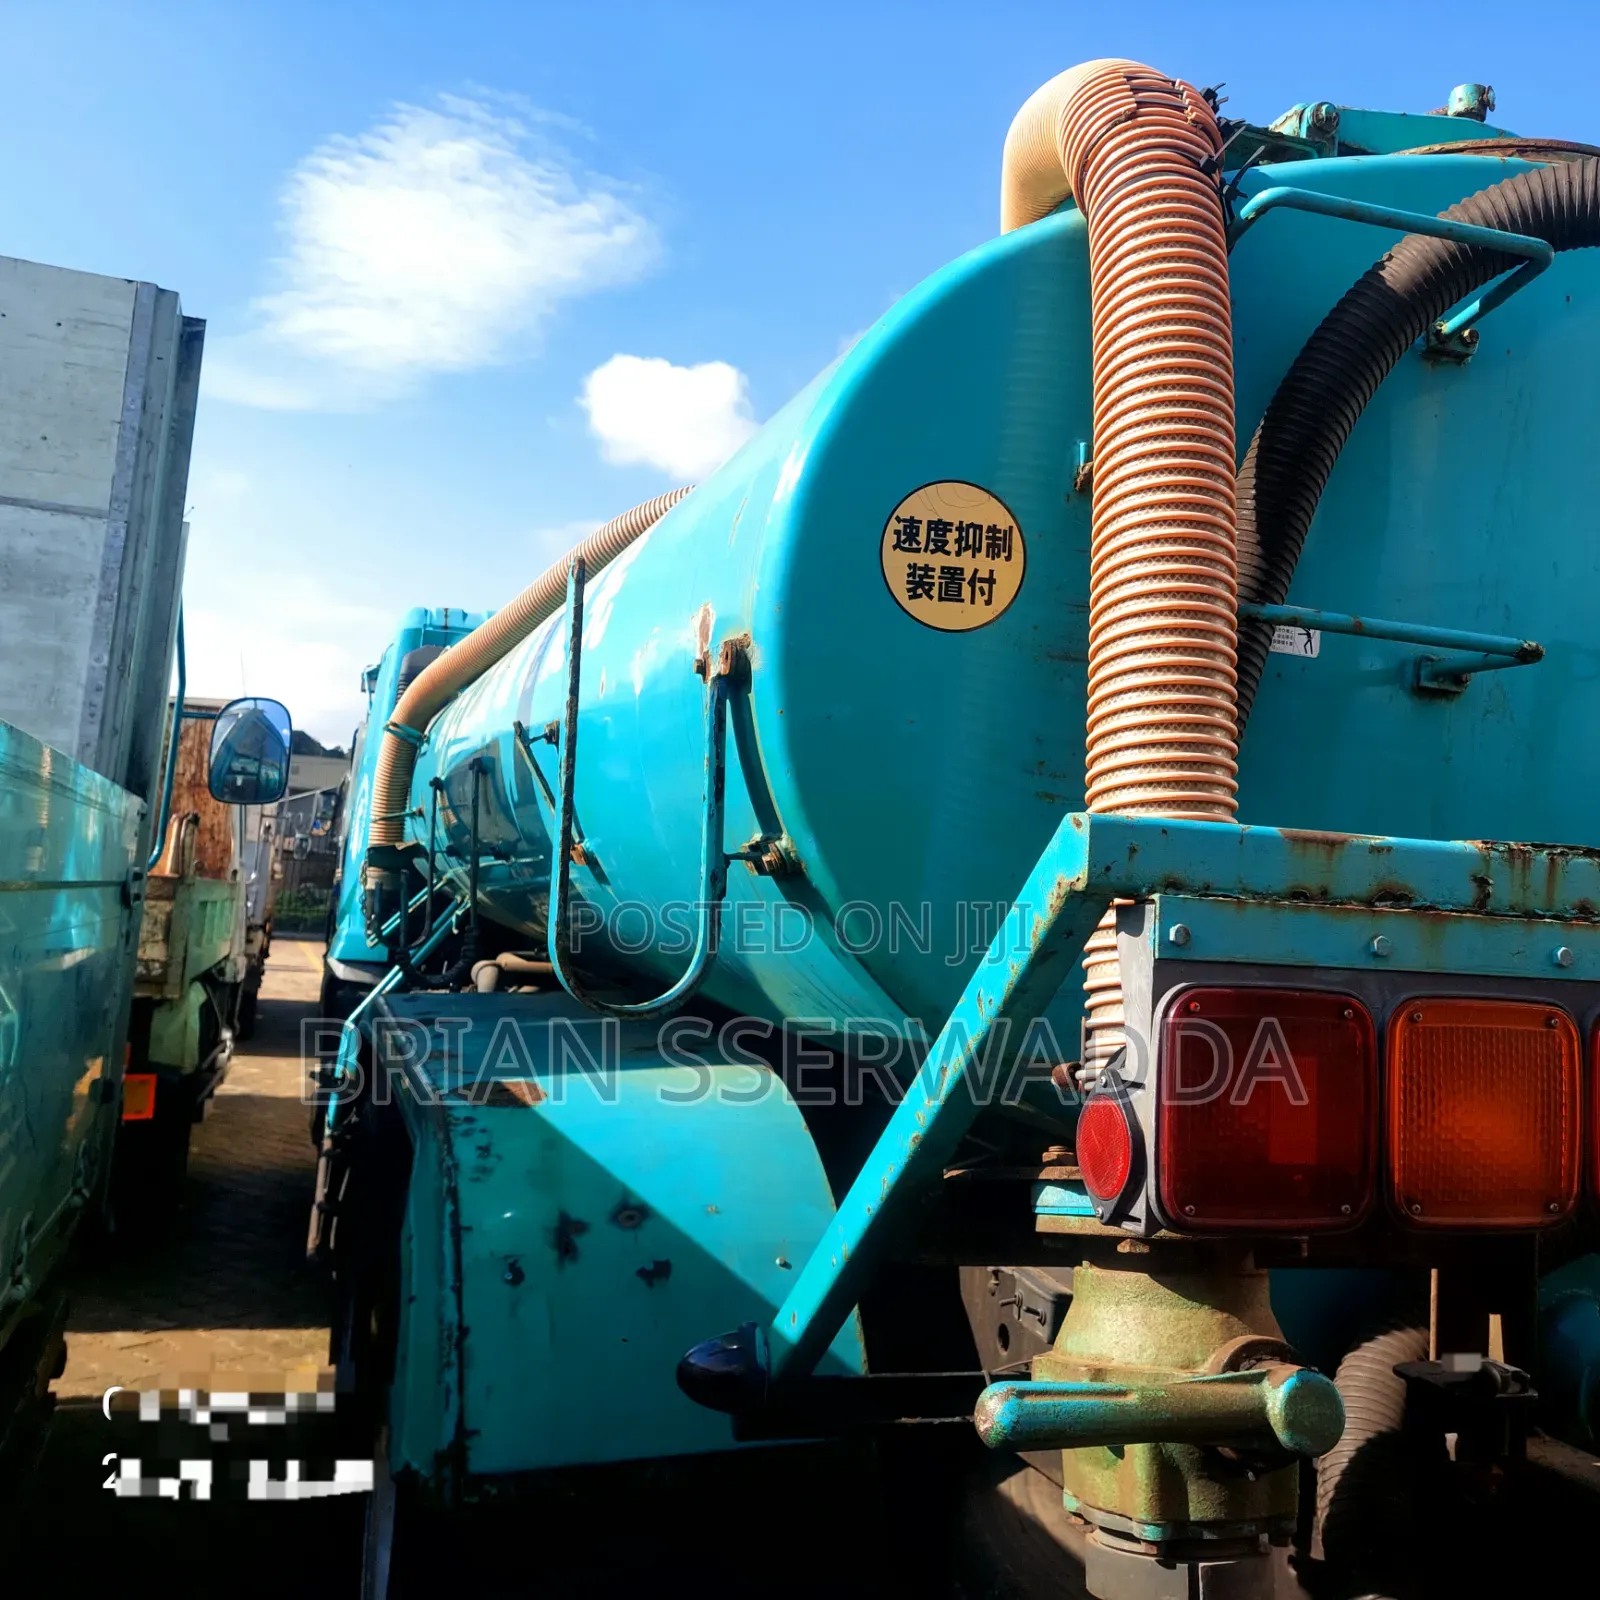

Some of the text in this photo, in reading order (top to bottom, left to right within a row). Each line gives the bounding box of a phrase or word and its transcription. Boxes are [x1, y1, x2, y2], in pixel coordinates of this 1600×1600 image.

[892, 515, 1014, 562] 速度抑制
[906, 562, 997, 606] 装置付
